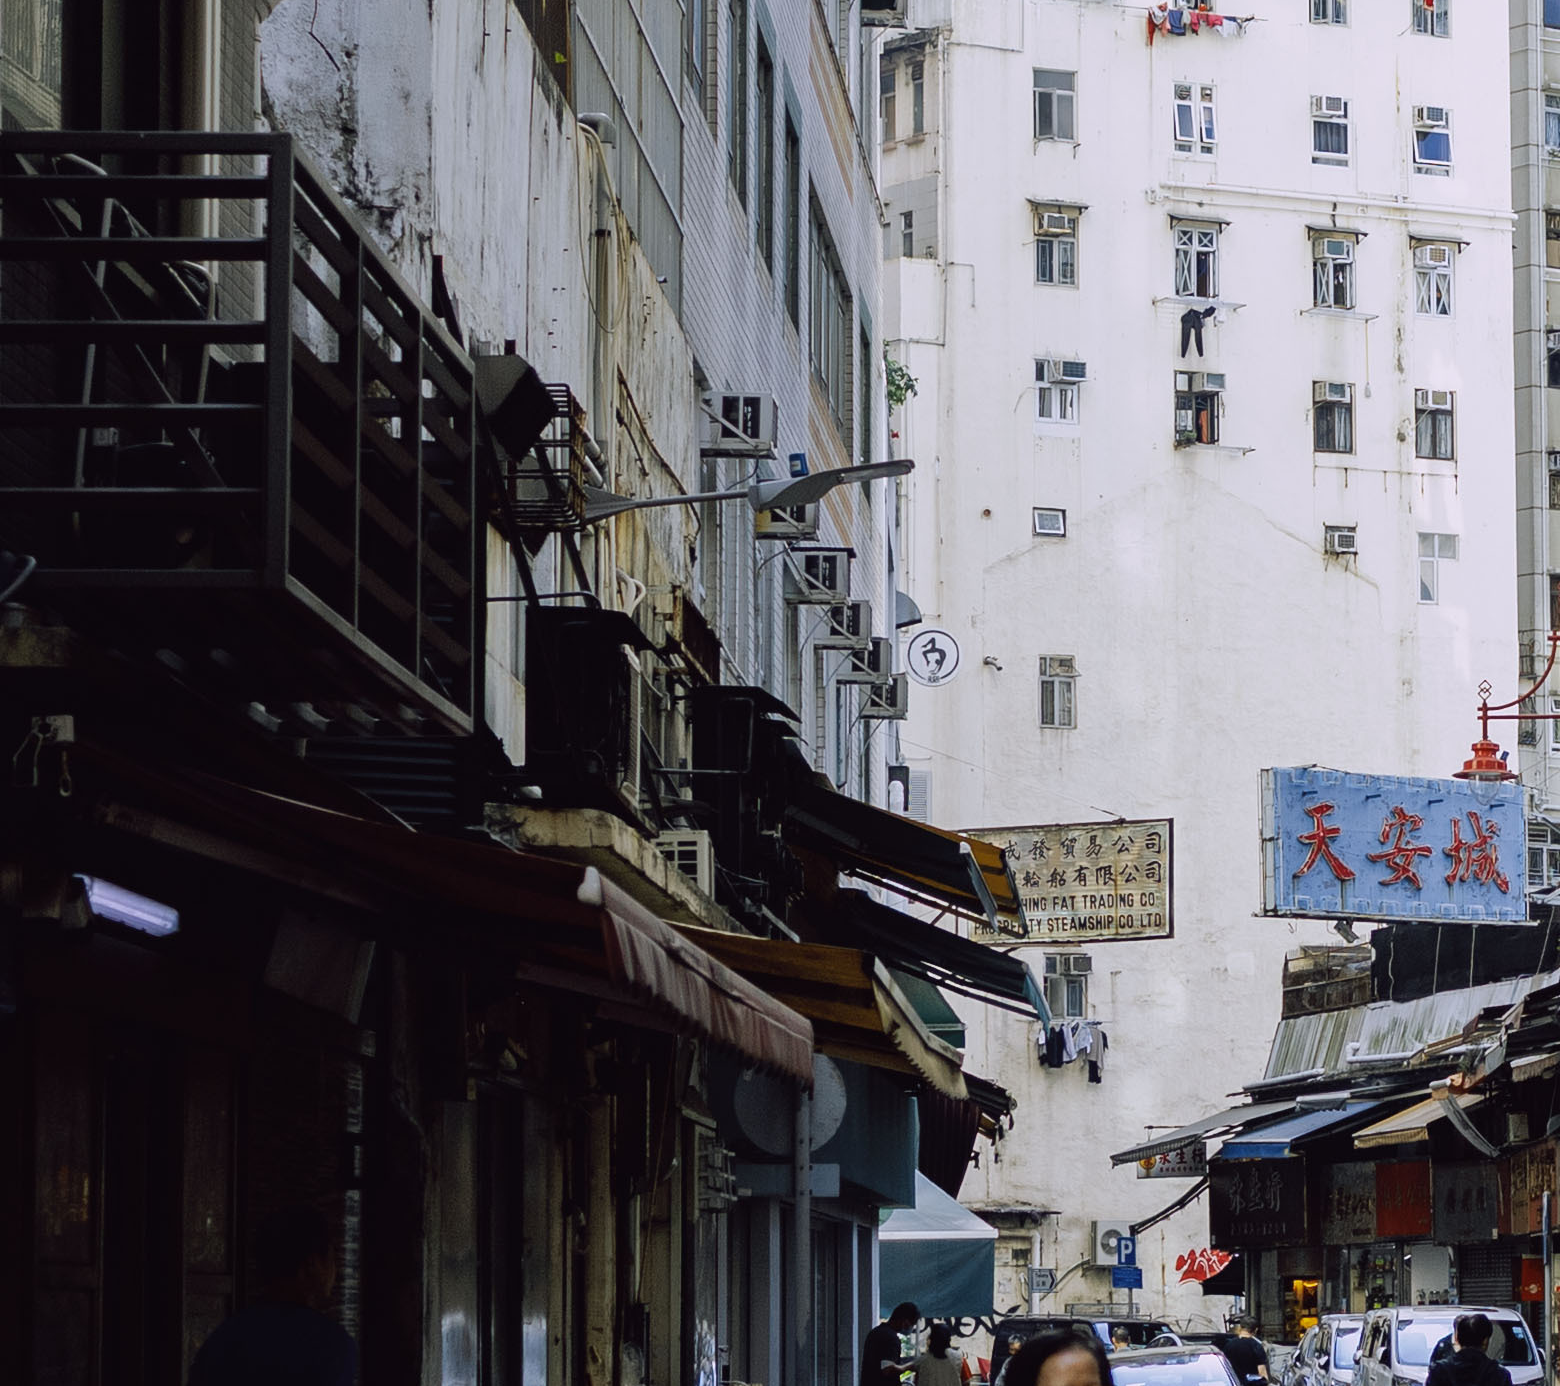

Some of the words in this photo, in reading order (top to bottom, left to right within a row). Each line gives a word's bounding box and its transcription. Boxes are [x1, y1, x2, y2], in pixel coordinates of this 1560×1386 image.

[1296, 802, 1510, 893] 天安城
[1011, 861, 1162, 889] 輪船有限公司
[1020, 897, 1047, 912] HING
[1052, 896, 1076, 911] FAT
[1082, 893, 1134, 910] TRADING
[1047, 915, 1114, 933] STEAMSHIP
[1120, 1239, 1133, 1263] P
